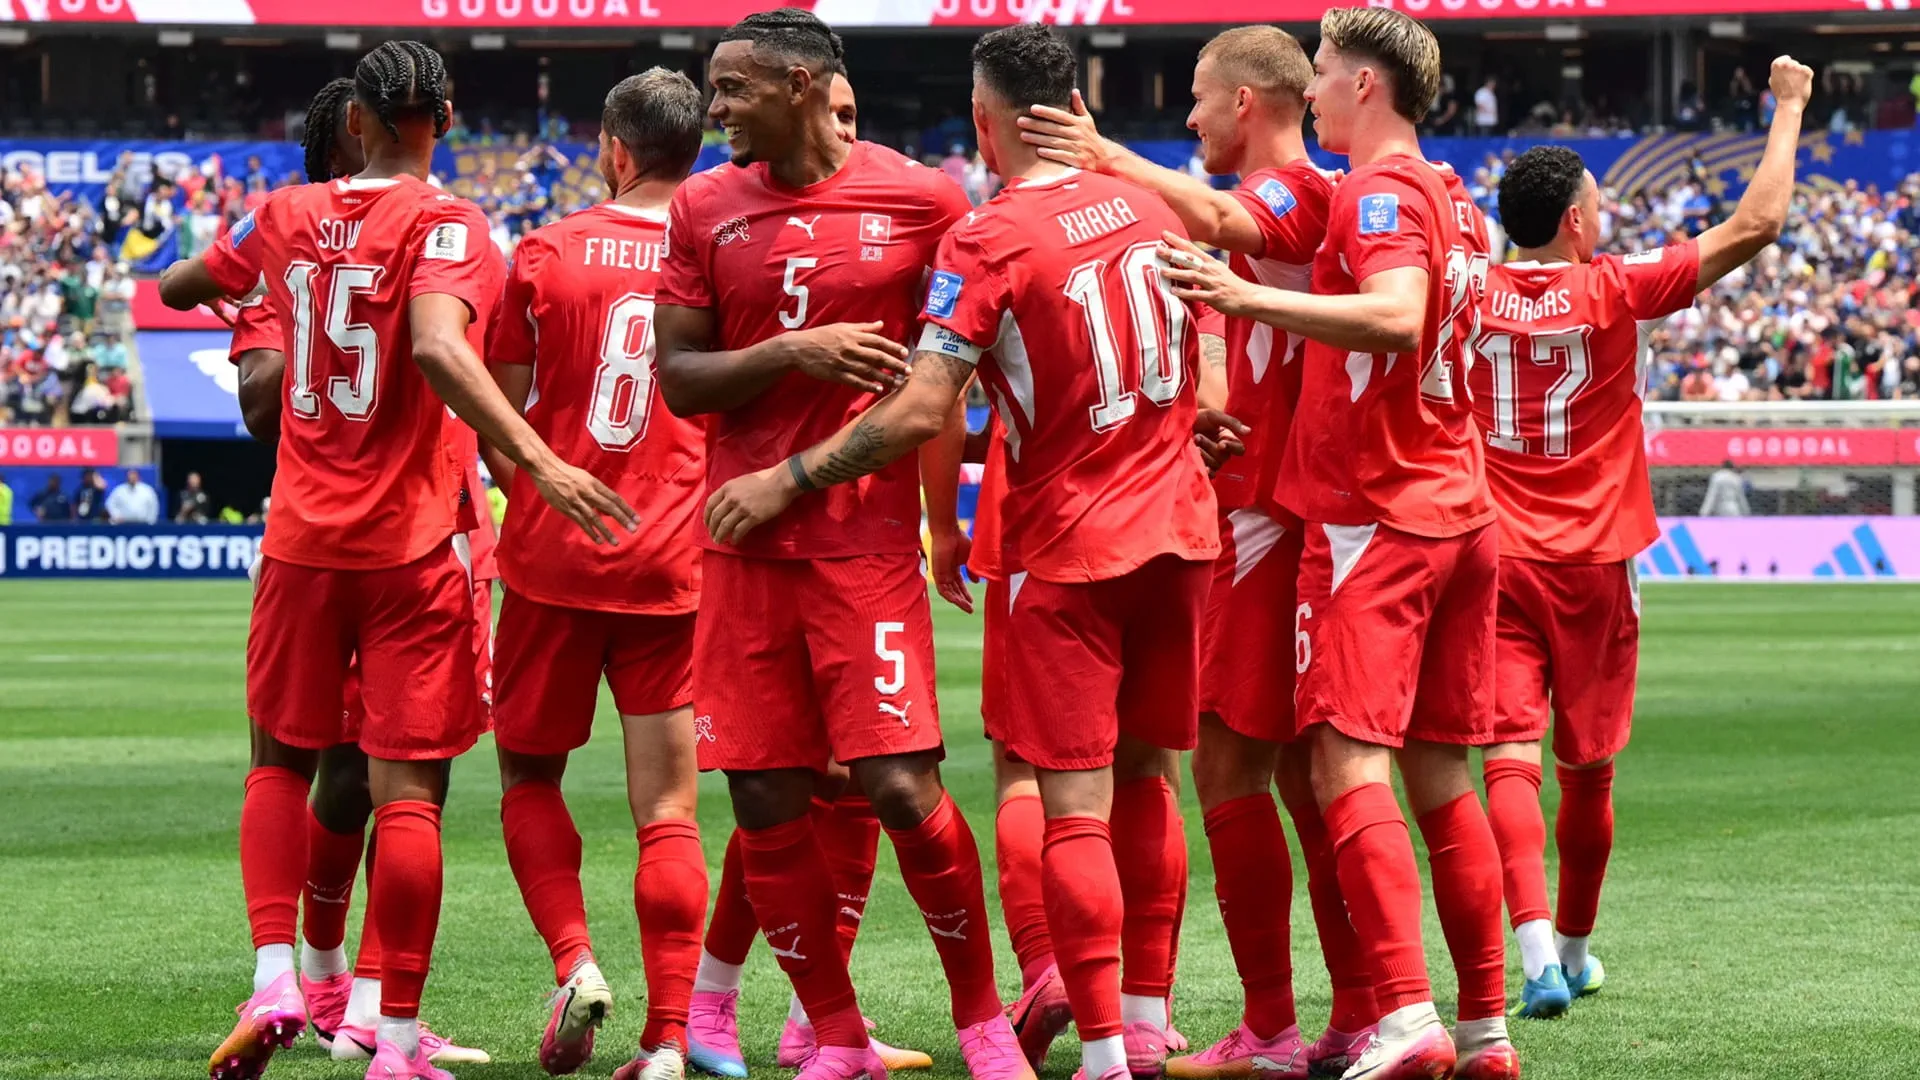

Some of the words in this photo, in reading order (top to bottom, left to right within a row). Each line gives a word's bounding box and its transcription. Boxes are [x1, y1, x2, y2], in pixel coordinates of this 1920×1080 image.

[1057, 197, 1138, 244] XHAKA
[779, 257, 820, 329] 5
[1491, 288, 1571, 322] VARGAS
[284, 260, 386, 421] 15
[586, 291, 657, 453] 8
[943, 343, 958, 351] FIFA
[1063, 240, 1190, 434] 10
[1475, 324, 1594, 460] 17
[874, 622, 905, 695] 5
[1295, 602, 1312, 674] 6
